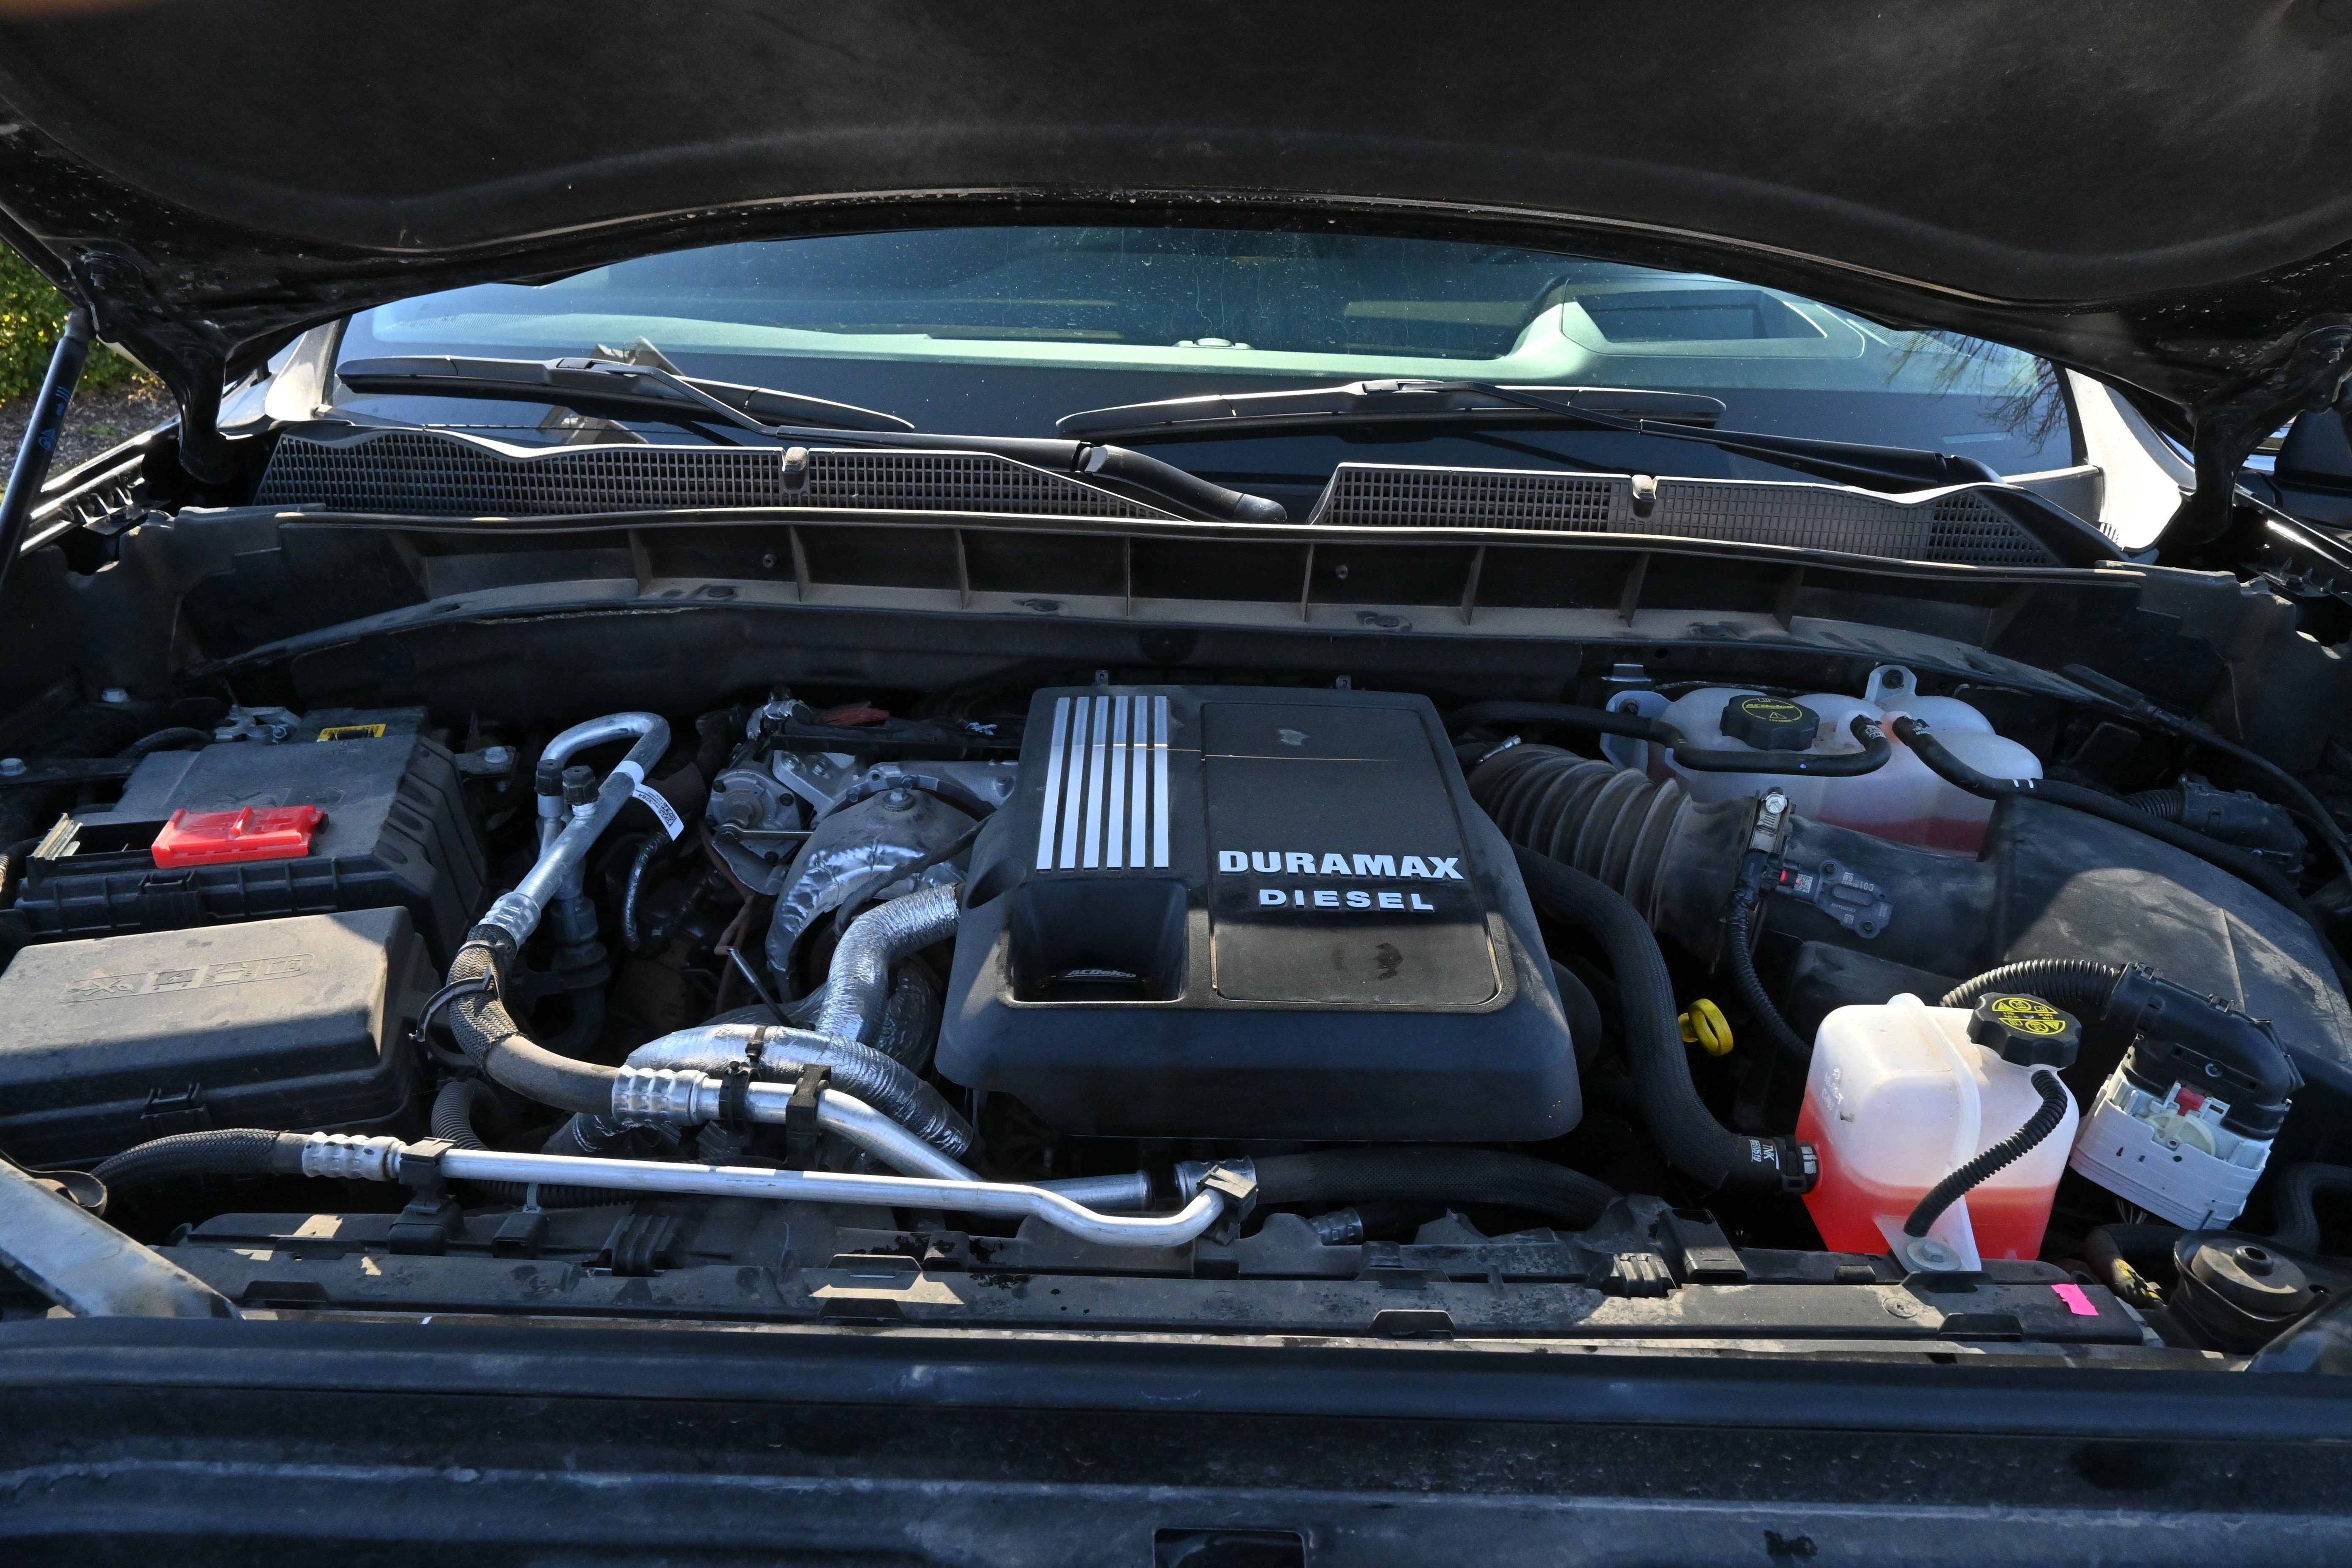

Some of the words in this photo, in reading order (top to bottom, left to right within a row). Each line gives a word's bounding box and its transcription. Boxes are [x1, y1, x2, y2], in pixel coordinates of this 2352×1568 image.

[1219, 850, 1464, 880] DURAMAX
[1259, 889, 1434, 912] DIESEL
[1064, 969, 1137, 978] ACDelco
[1762, 1143, 1775, 1161] TNK
